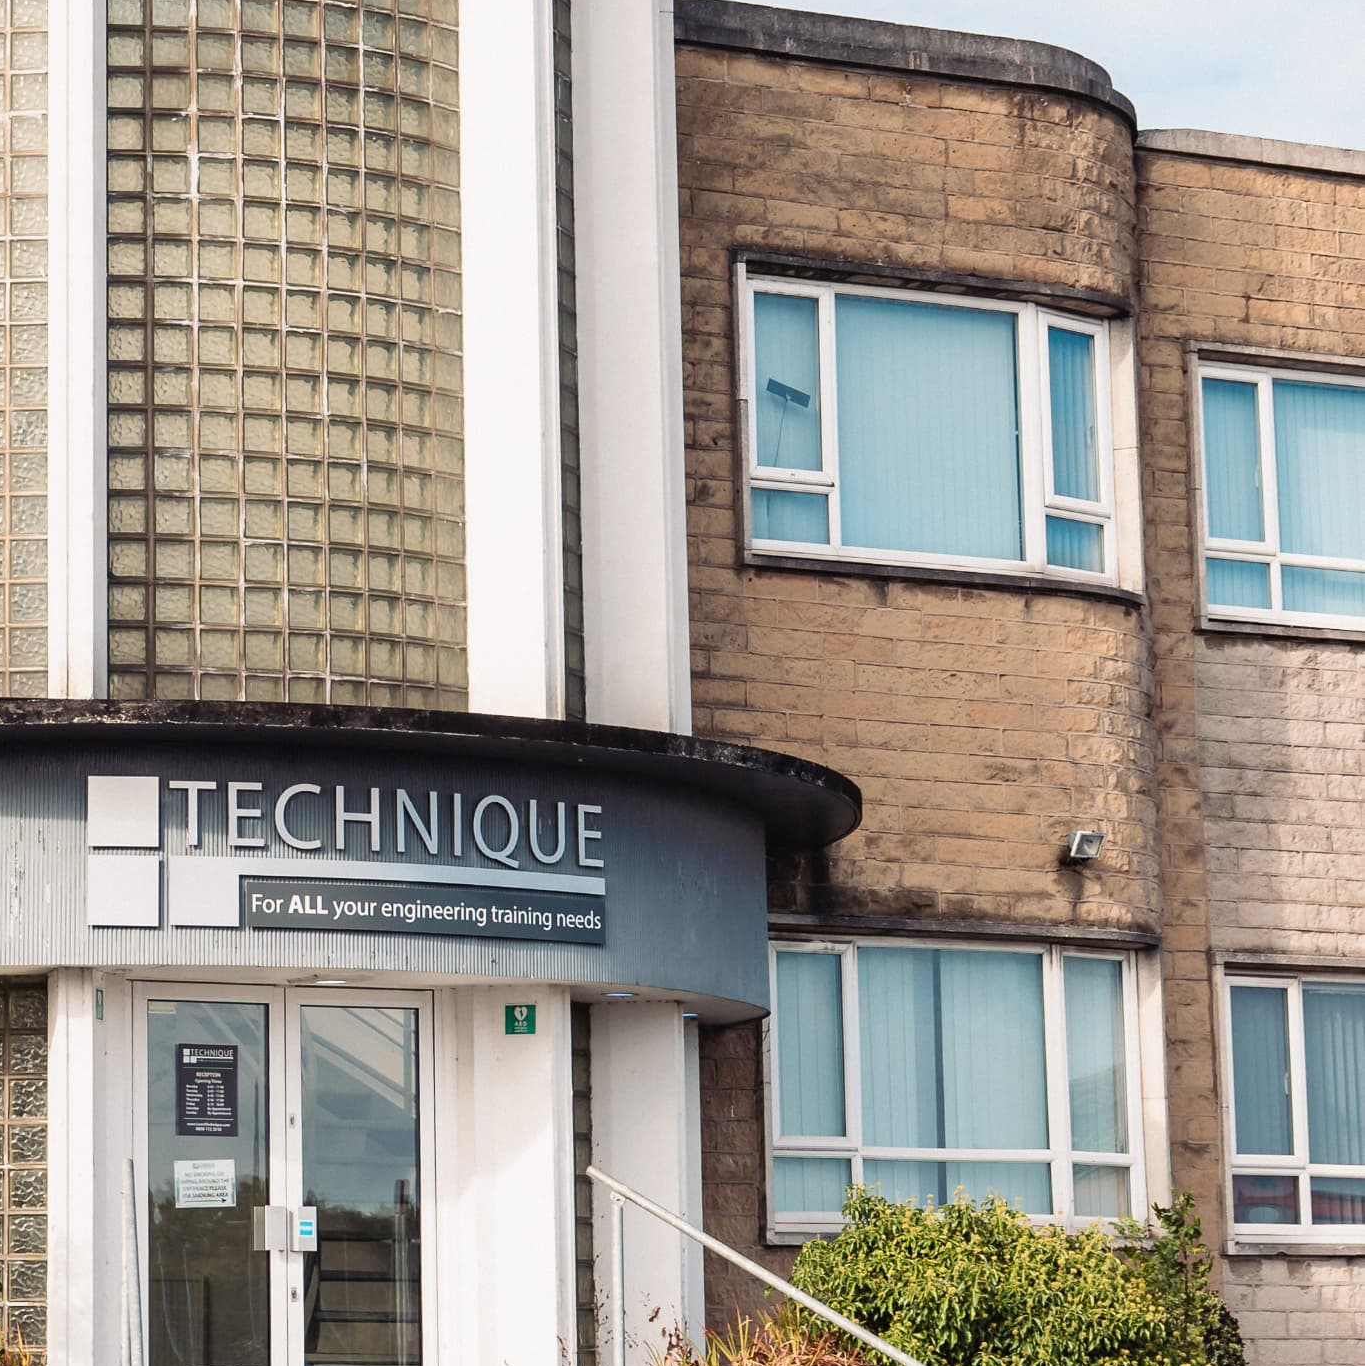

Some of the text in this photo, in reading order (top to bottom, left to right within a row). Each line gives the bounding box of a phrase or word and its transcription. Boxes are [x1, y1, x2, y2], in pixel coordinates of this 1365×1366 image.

[169, 780, 605, 869] TECHNIQUE
[251, 893, 602, 931] For ALL your engineering training needs
[190, 1048, 234, 1058] TECHNIQUE
